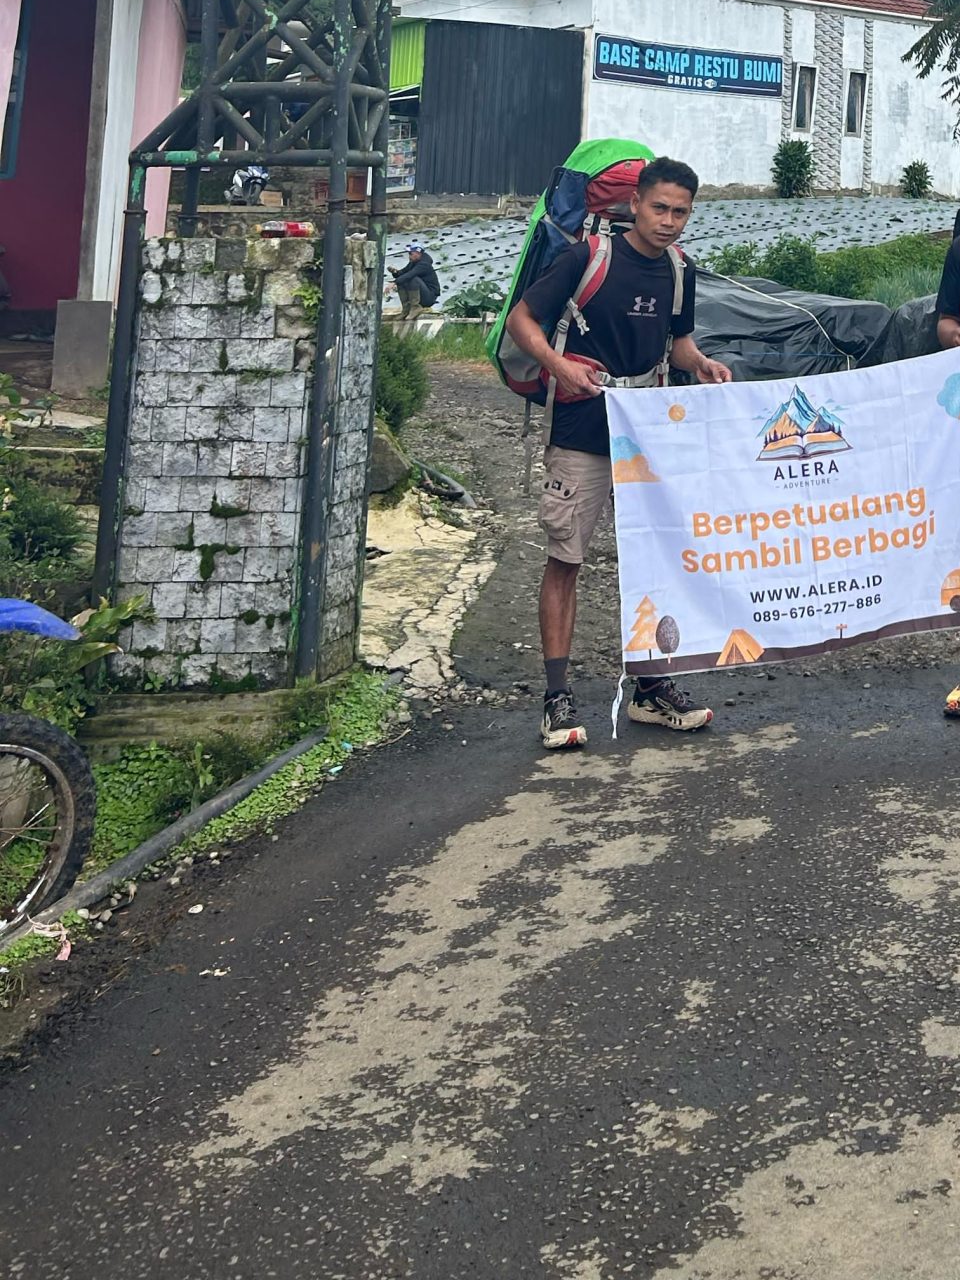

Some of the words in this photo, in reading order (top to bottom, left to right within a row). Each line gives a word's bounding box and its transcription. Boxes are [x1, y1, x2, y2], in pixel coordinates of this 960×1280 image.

[599, 41, 640, 69] BASE
[644, 48, 690, 74] CAMP
[694, 54, 739, 79] RESTU
[743, 60, 781, 84] BUMI
[667, 74, 703, 88] GRATIS
[773, 459, 839, 481] ALERA
[783, 478, 831, 489] ADVENTURE
[692, 486, 926, 540] Berpetualang
[681, 534, 802, 574] Sambil
[811, 510, 936, 562] Berbagi
[750, 574, 883, 604] WWW.ALERA.ID
[752, 593, 881, 623] 089-676-277-886
